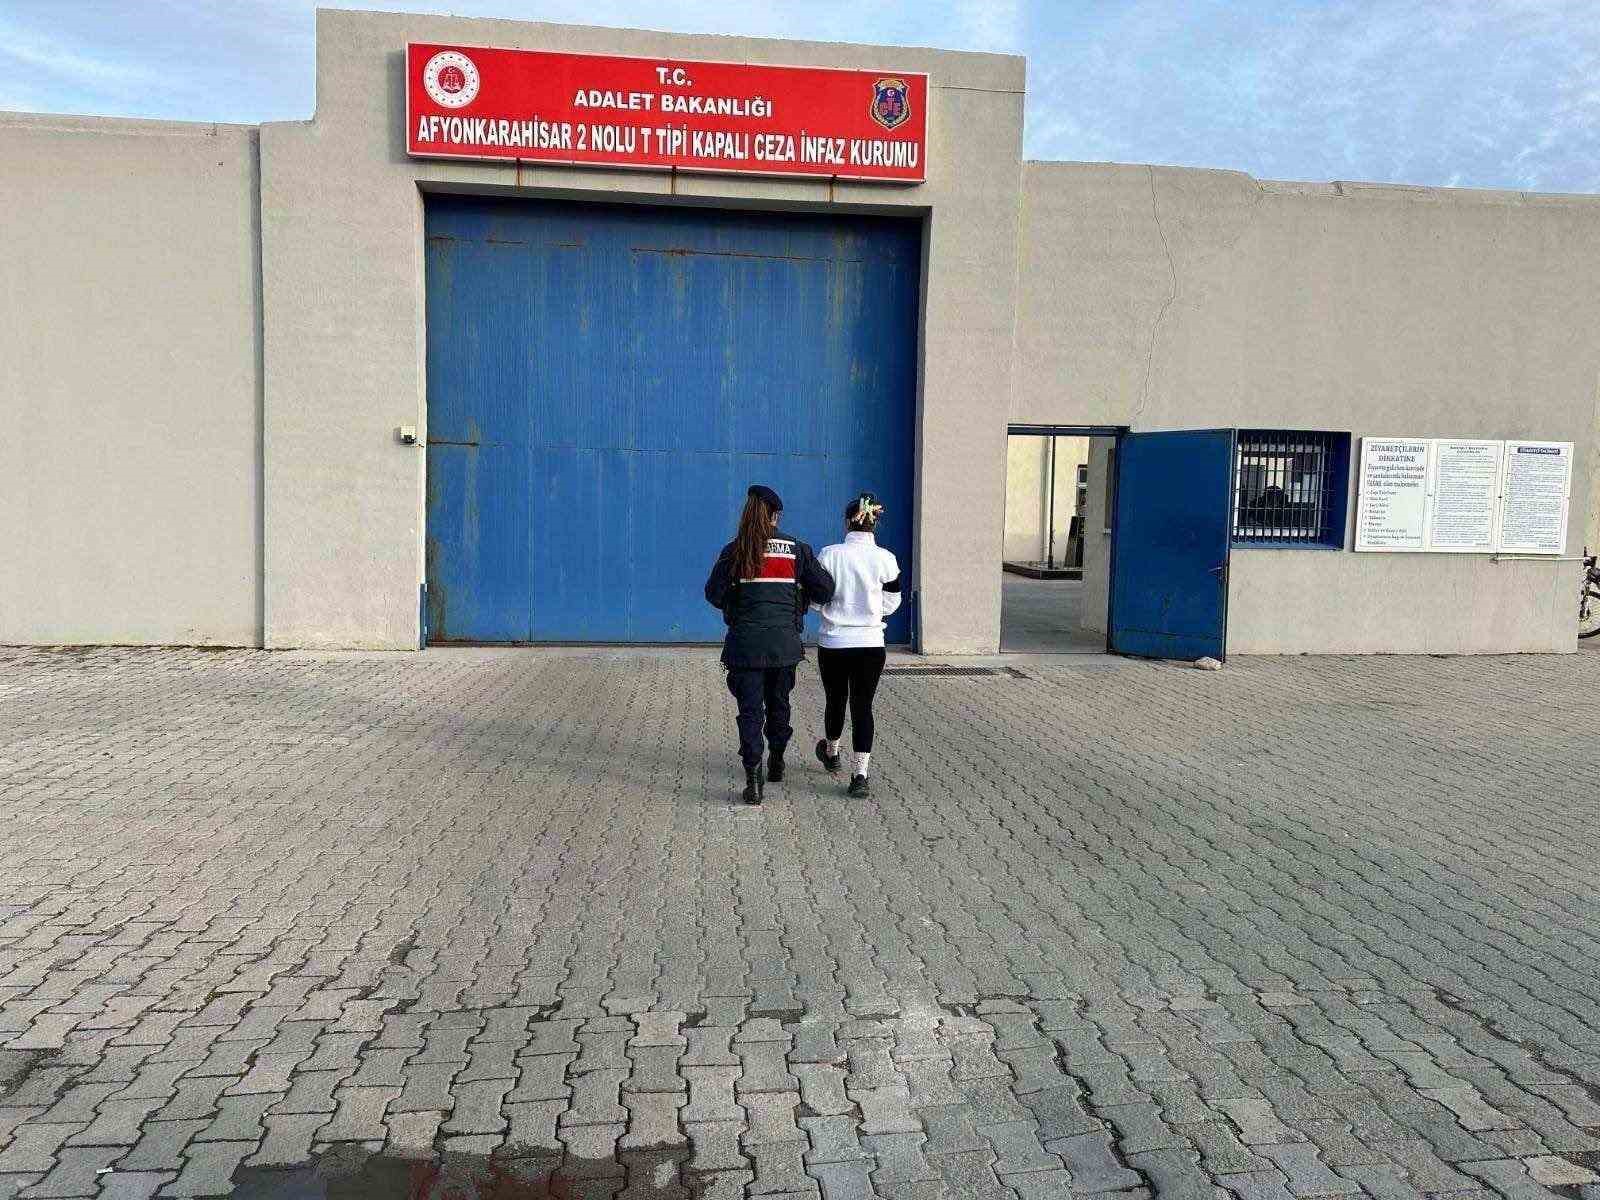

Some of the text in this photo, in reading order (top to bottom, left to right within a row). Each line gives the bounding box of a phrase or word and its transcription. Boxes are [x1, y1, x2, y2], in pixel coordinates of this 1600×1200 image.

[656, 66, 692, 86] T.C.
[574, 89, 772, 118] ADALET BAKANLIĞI
[418, 115, 918, 168] AFYONKARAHİSAR 2 NOLU T TİPİ KAPALI CEZA İNFAZ KURUMU
